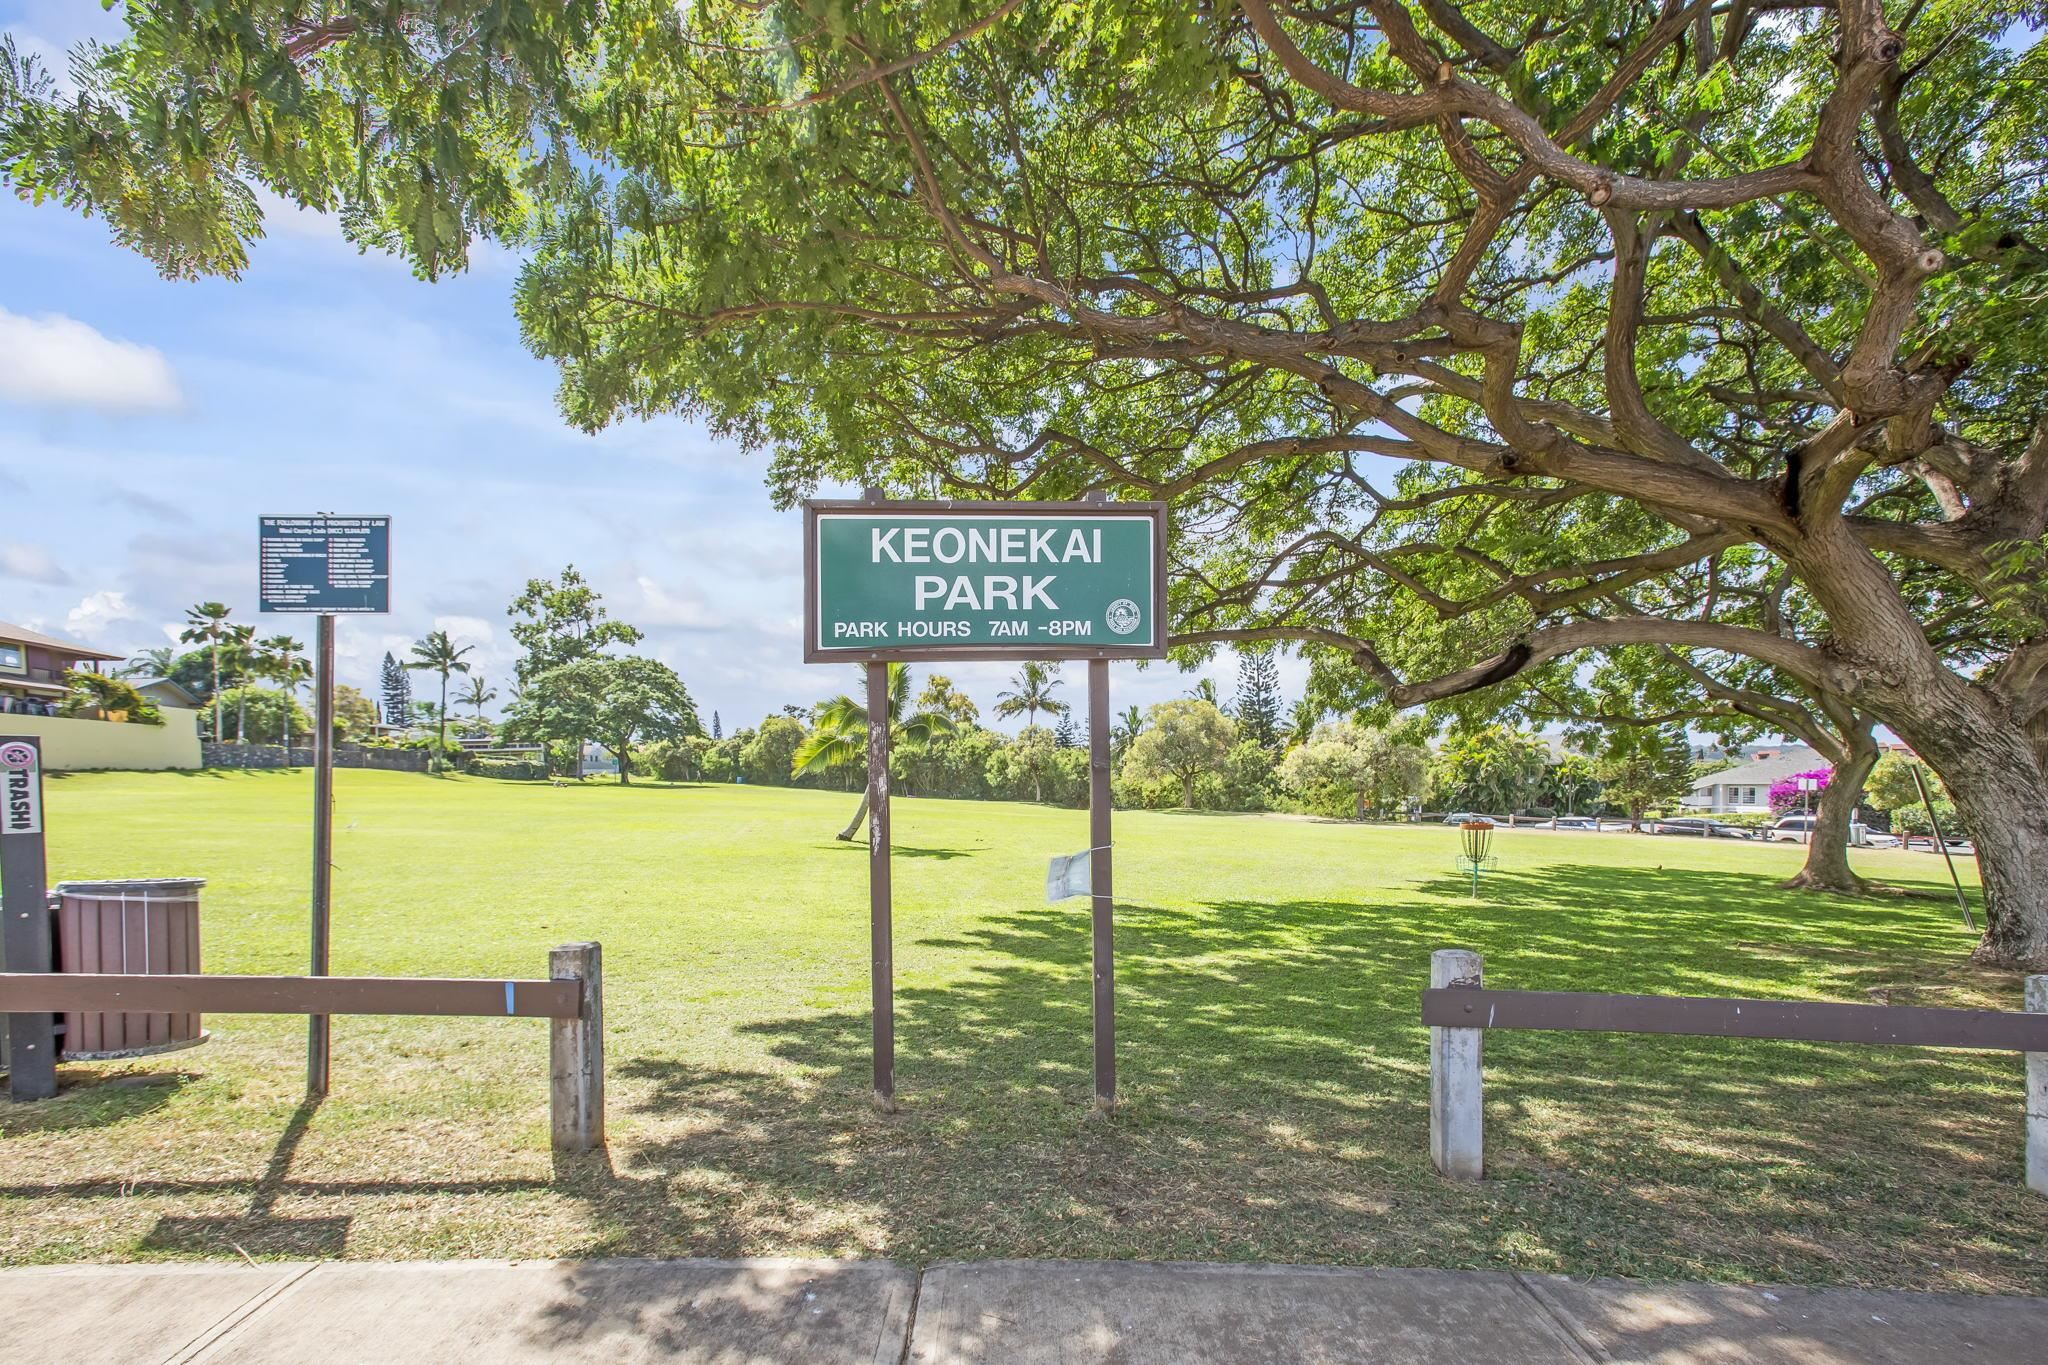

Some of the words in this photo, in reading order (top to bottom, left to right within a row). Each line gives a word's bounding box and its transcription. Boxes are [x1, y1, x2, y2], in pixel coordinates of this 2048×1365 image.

[871, 527, 1102, 564] KEONEKAI
[915, 575, 1060, 611] PARK
[835, 621, 889, 638] PARK
[899, 620, 971, 637] HOURS
[988, 620, 1028, 637] 7AM
[9, 769, 31, 822] TRASH
